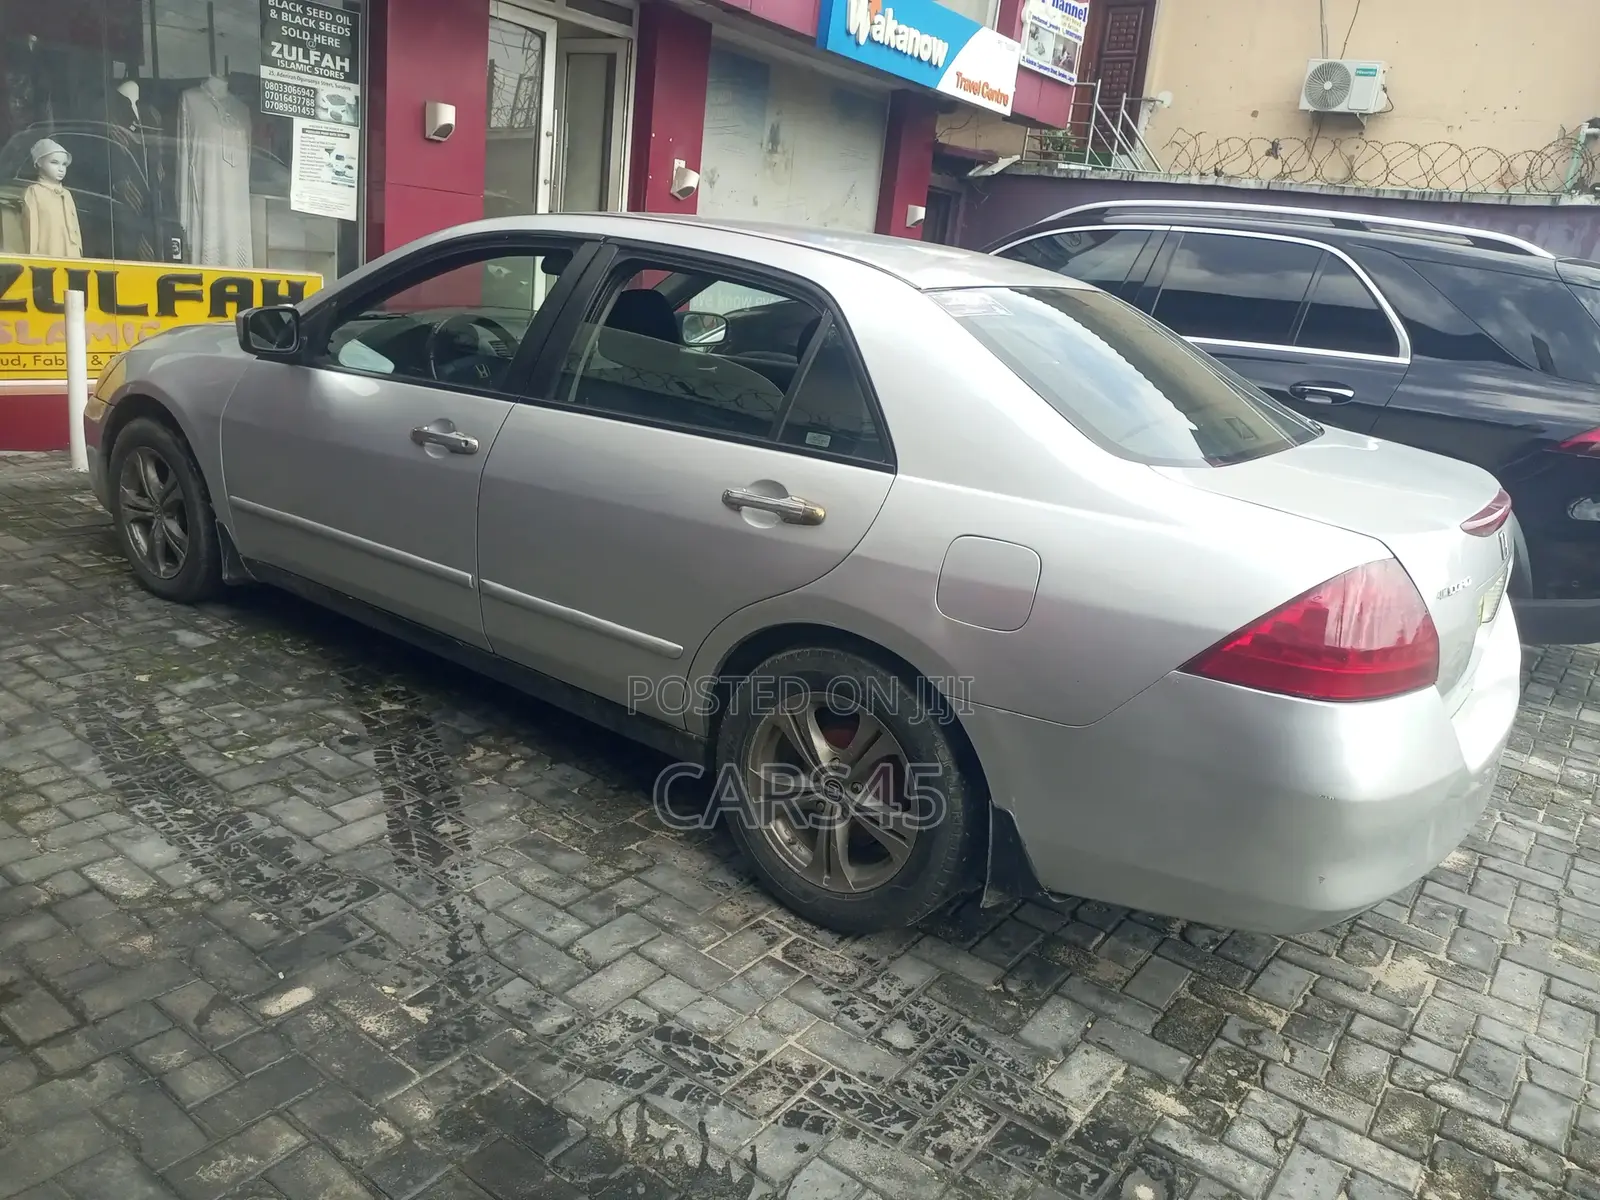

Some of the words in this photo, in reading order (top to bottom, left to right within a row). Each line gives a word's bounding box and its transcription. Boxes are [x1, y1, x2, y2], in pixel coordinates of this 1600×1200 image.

[269, 9, 278, 19] &
[281, 12, 316, 29] BLACK
[319, 22, 351, 37] SEEDS
[306, 7, 333, 21] SEED
[336, 14, 352, 26] OIL
[281, 26, 311, 41] SOLD
[314, 34, 341, 48] HERE
[306, 38, 317, 50] @
[847, 0, 949, 68] Wakanow
[271, 41, 350, 73] ZULFAH
[277, 59, 312, 74] ISLAMIC
[314, 66, 345, 80] STORES
[264, 80, 315, 98] 08033066942
[264, 91, 315, 108] 07016437788
[956, 71, 982, 96] Travel
[981, 82, 1009, 107] Centre
[265, 100, 315, 117] 07089501453
[0, 263, 307, 318] ZULFAH
[0, 320, 160, 346] SLAMIC
[0, 355, 27, 368] ud,
[33, 355, 65, 366] Fab
[91, 355, 103, 366] &
